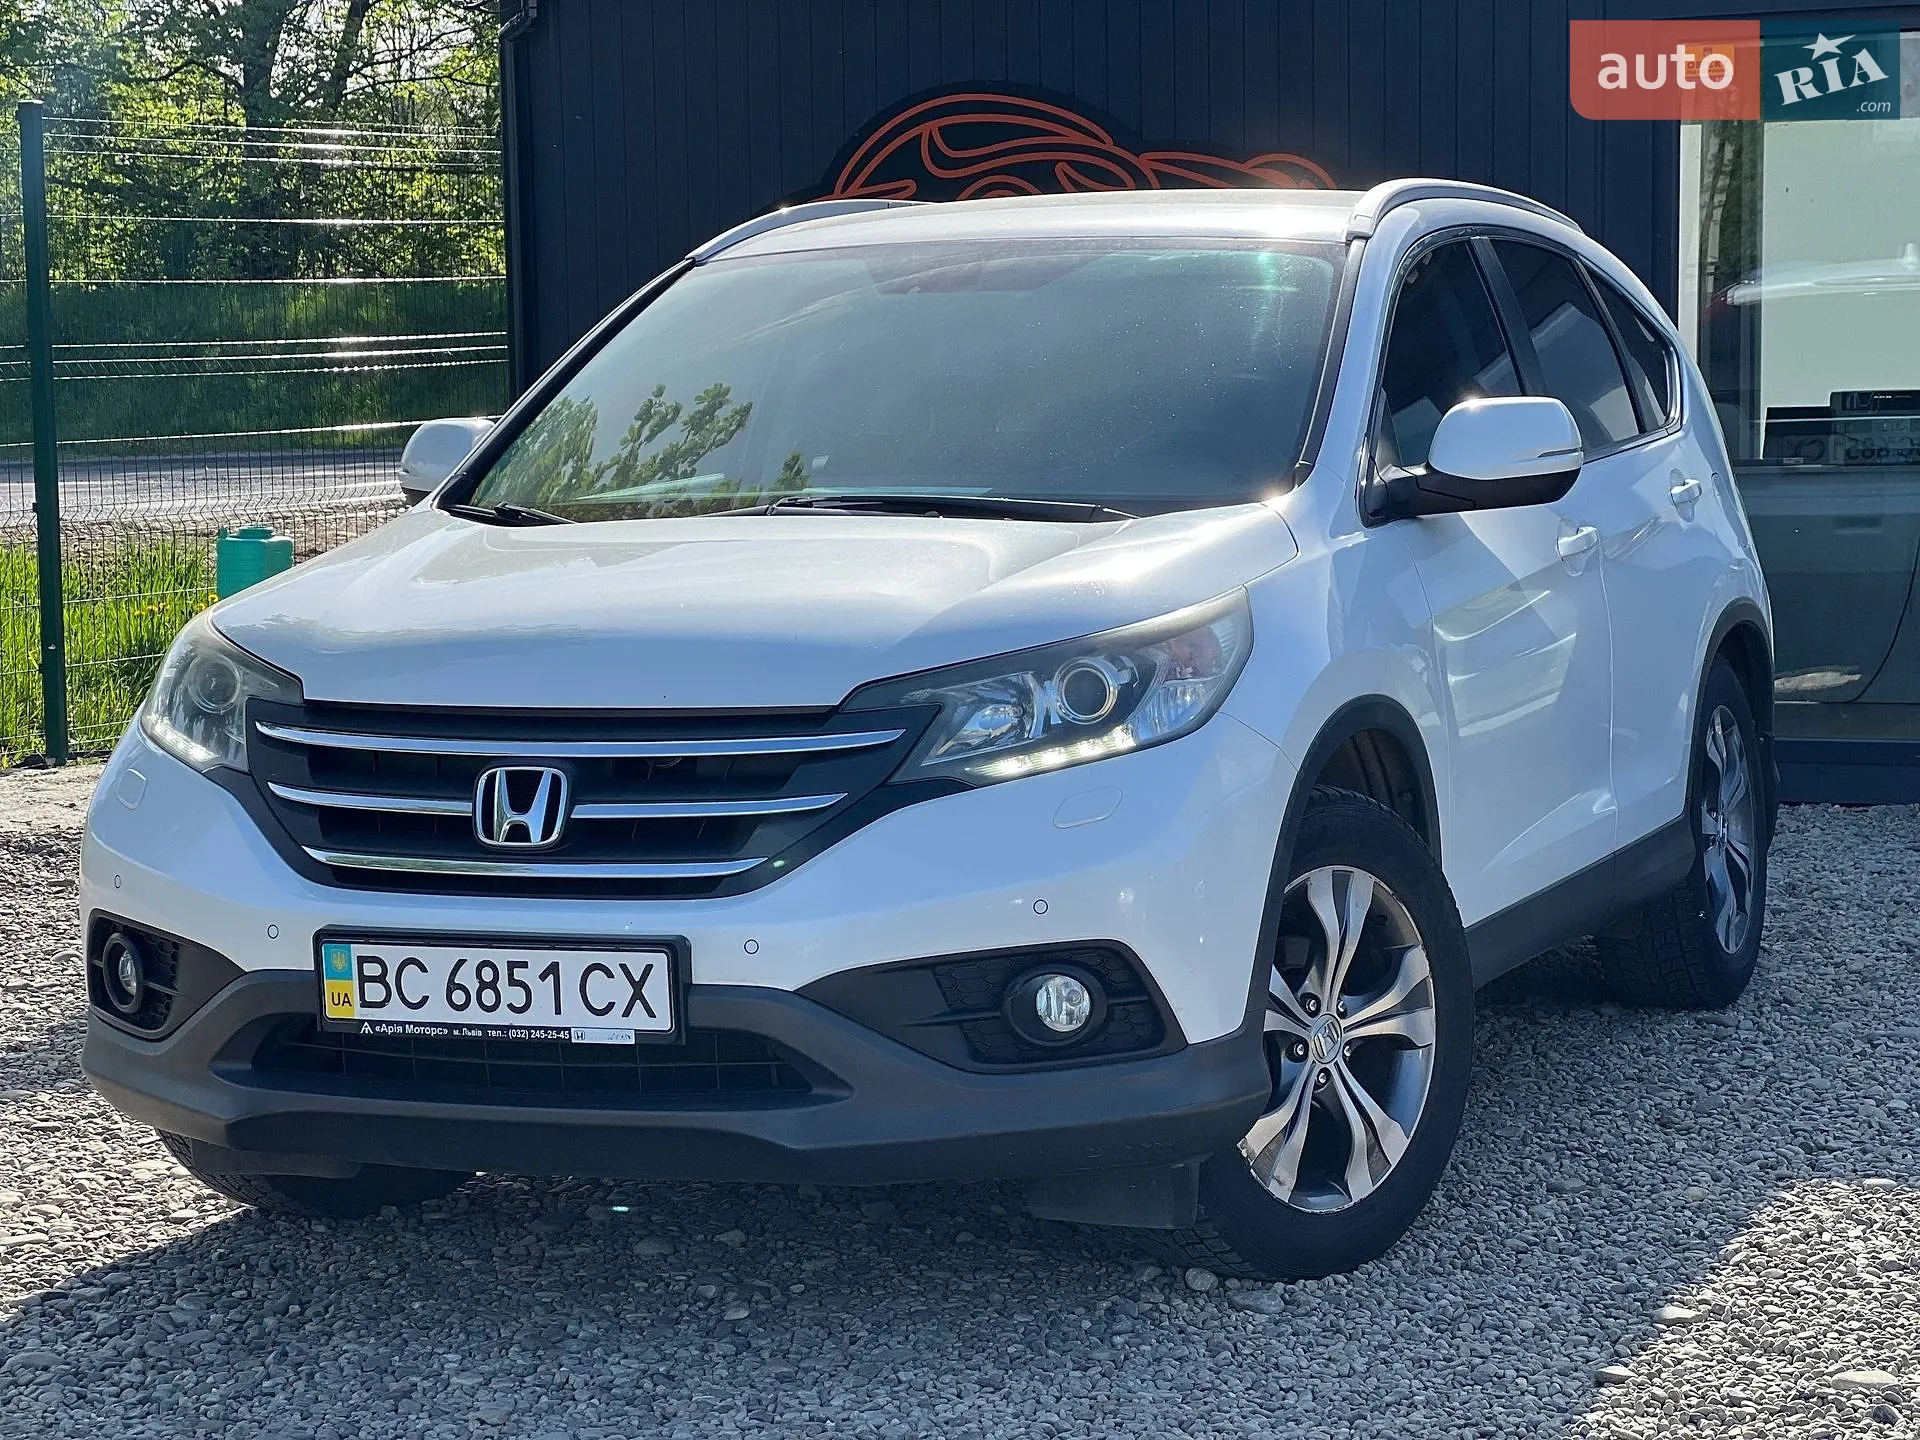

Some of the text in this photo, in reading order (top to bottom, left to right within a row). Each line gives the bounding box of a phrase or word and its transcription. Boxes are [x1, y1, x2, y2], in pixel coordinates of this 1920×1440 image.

[356, 955, 657, 1019] BC 6851 CX
[331, 992, 352, 1007] UA
[375, 1023, 403, 1036] «Арія
[405, 1024, 448, 1037] Моторс»
[487, 1029, 508, 1038] тел.:
[508, 1029, 529, 1040] (032)
[530, 1030, 570, 1040] 245-25-45
